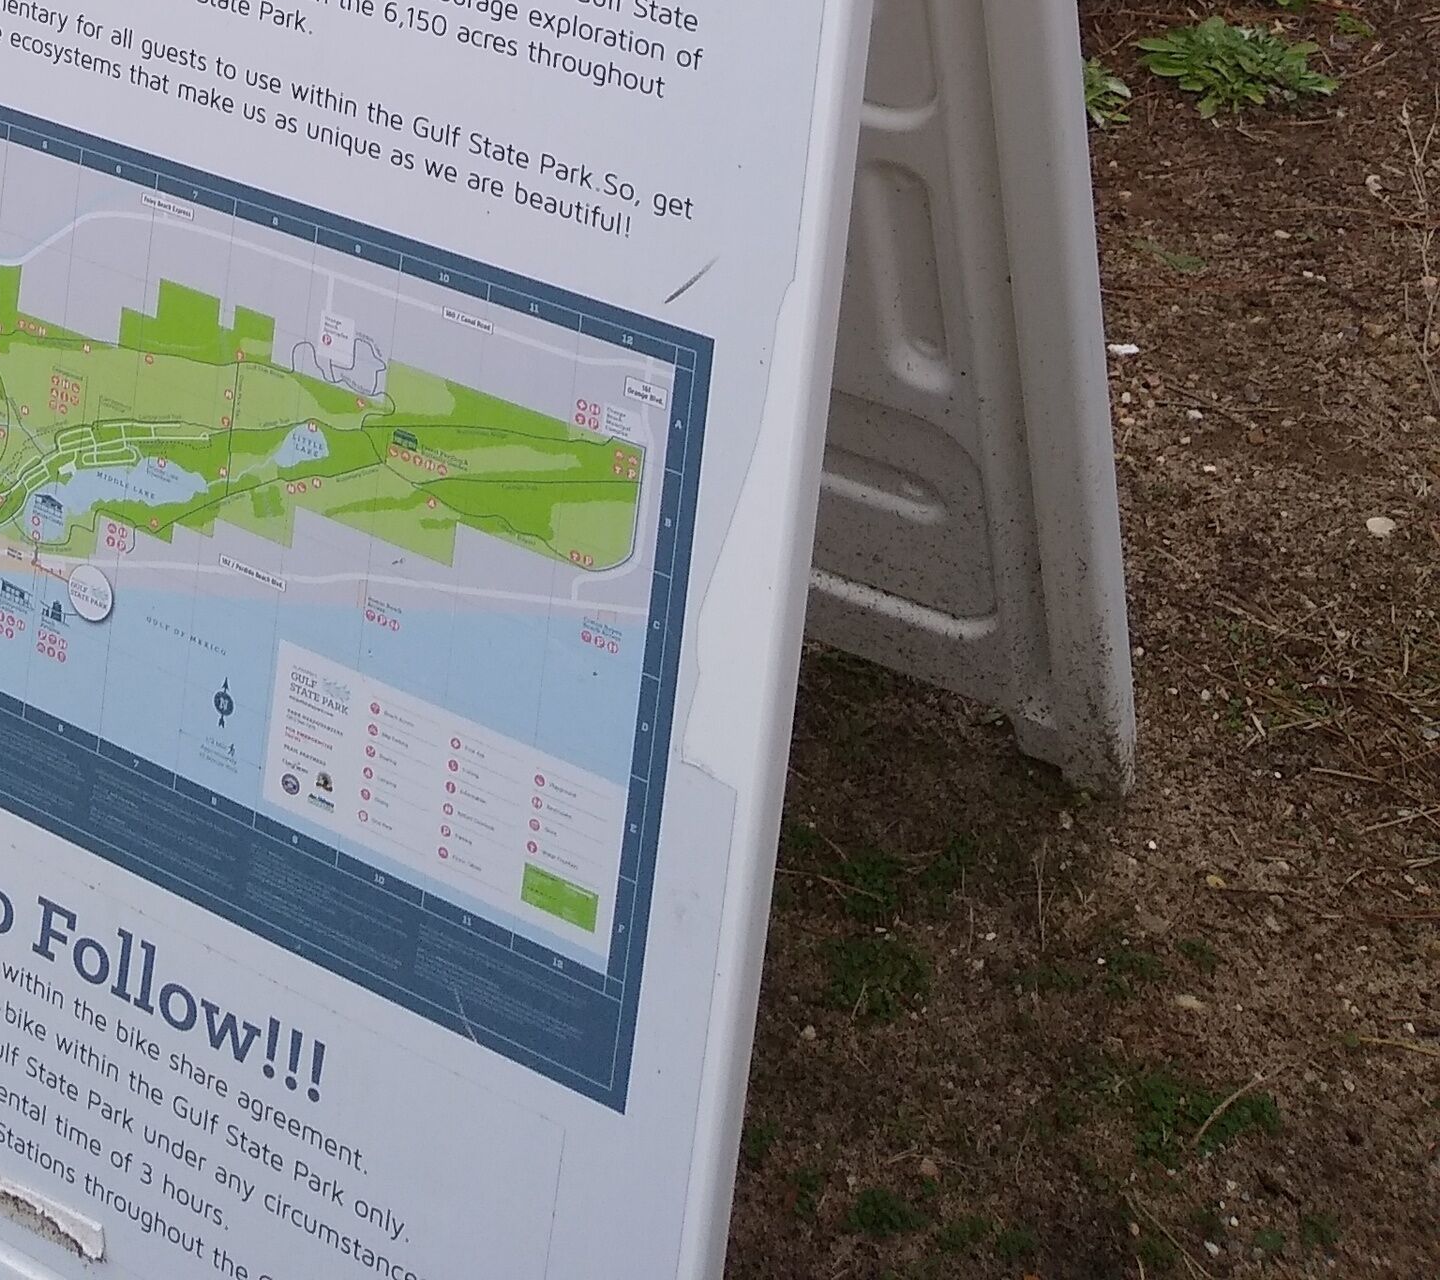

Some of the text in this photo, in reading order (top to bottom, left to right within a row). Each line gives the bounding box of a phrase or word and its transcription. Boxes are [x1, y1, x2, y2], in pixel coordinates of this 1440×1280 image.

[132, 484, 156, 500] LAKE
[289, 682, 320, 703] STATE
[322, 696, 349, 715] PARK
[290, 671, 318, 689] GULF
[31, 894, 326, 1103] Follow!!!
[2, 961, 64, 1011] within
[73, 996, 107, 1033] the
[116, 1018, 161, 1062] bike
[168, 1052, 228, 1099] share
[237, 1090, 368, 1177] agreement.
[4, 999, 47, 1043] bike
[55, 1032, 119, 1083] within
[128, 1069, 164, 1106] the
[172, 1095, 220, 1136] Gulf
[225, 1123, 284, 1173] State
[293, 1159, 345, 1208] Park
[354, 1199, 410, 1244] only.
